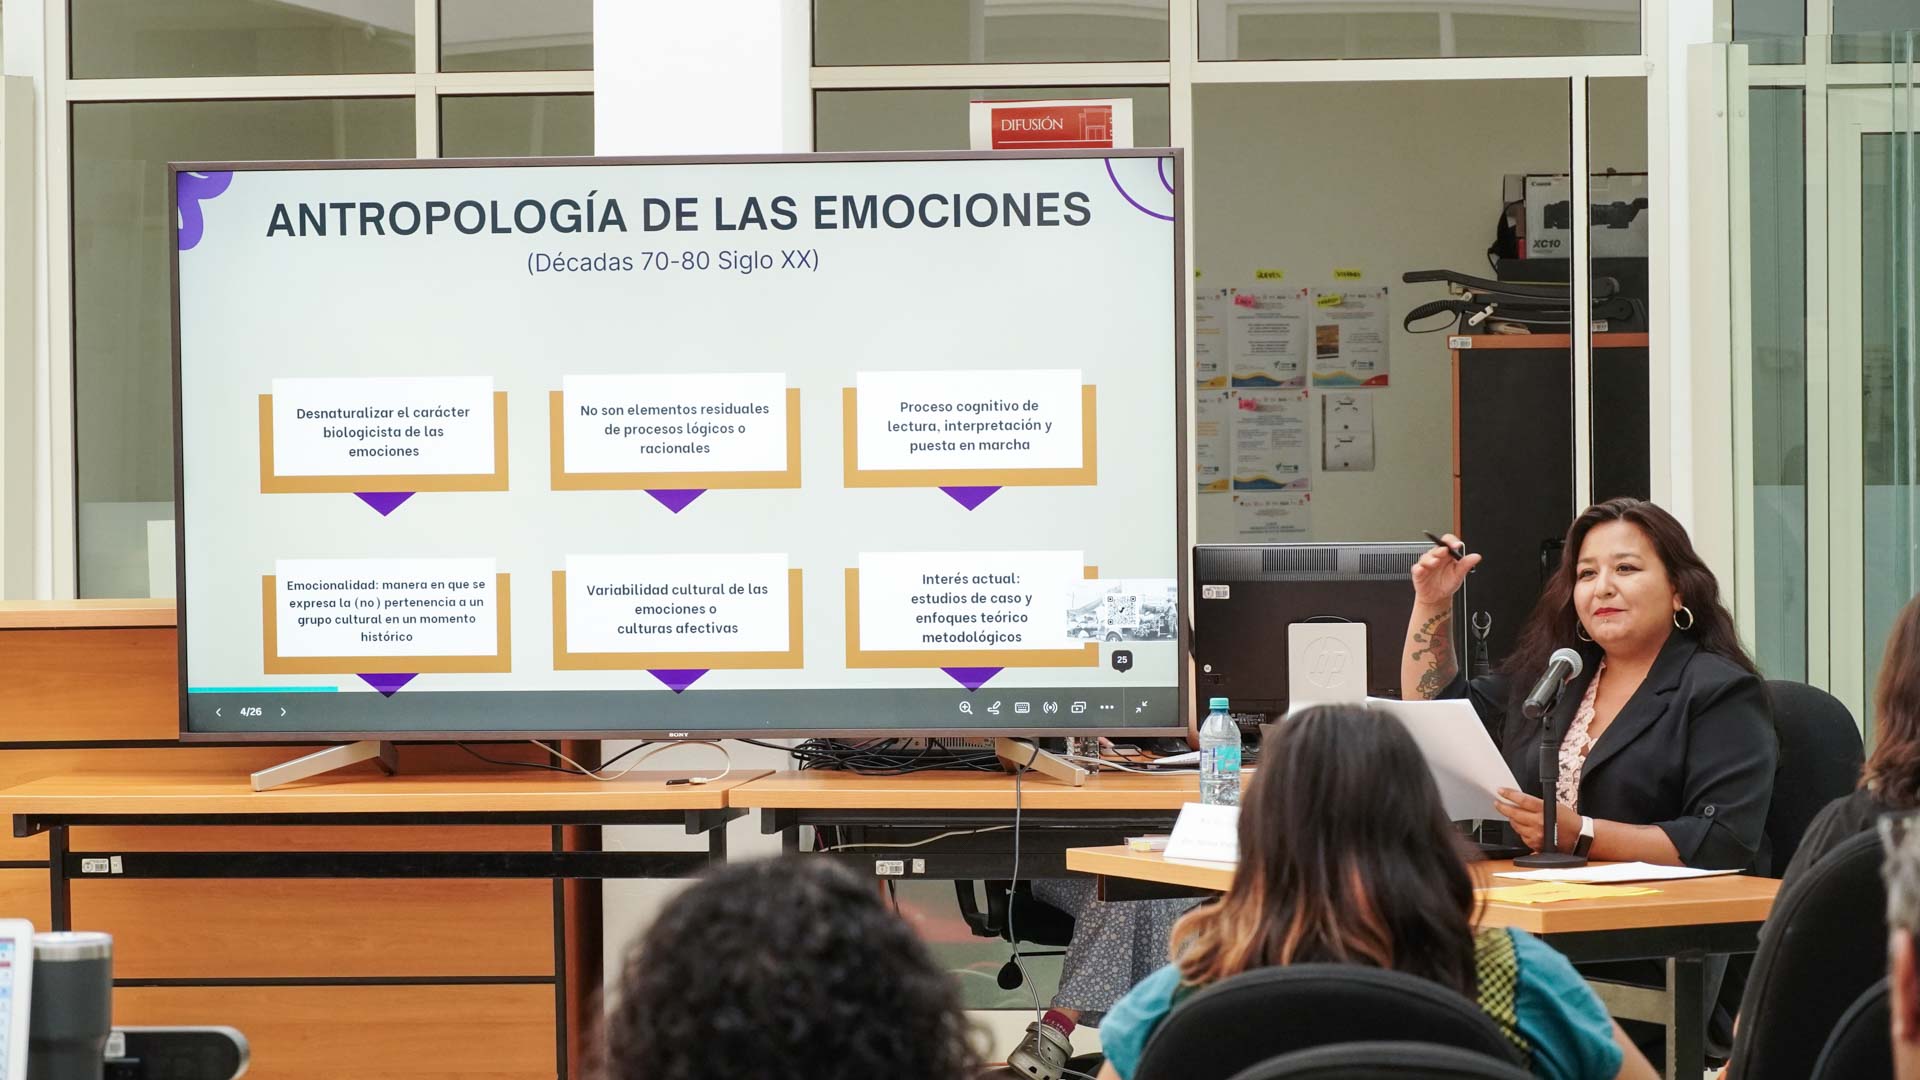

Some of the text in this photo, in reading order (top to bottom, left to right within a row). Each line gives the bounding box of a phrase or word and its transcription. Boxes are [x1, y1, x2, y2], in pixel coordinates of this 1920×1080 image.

[1001, 116, 1063, 131] DIFUSIÓN
[266, 190, 1091, 237] ANTROPOLOGÍA DE LAS EMOCIONES
[1533, 239, 1561, 249] XC10
[528, 249, 818, 276] (Décadas 70-80 Siglo XX)
[297, 405, 470, 419] Desnaturalizar el carácter
[581, 402, 769, 416] No son elementos residuales
[900, 399, 1039, 415] Proceso cognitivo de
[323, 425, 444, 439] biologicista de las
[604, 421, 746, 438] de procesos lógicos o
[888, 418, 1052, 434] lectura, interpretación y
[349, 445, 419, 457] emociones
[640, 442, 710, 454] racionales
[910, 438, 1030, 454] puesta en marcha
[287, 579, 378, 591] Emocionalidad:
[382, 582, 427, 590] manera
[448, 581, 469, 592] que
[473, 581, 485, 589] se
[923, 572, 1020, 585] Interés actual:
[586, 583, 768, 596] Variabilidad cultural de las
[289, 600, 336, 611] expresa
[339, 598, 351, 608] la
[384, 596, 456, 610] pertenencia
[459, 599, 466, 607] a
[469, 599, 484, 607] un
[911, 592, 1032, 607] estudios de caso y
[635, 602, 717, 615] emociones o
[298, 614, 476, 627] grupo cultural en un momento
[916, 610, 1028, 626] enfoques teórico
[617, 621, 738, 634] culturas afectivas
[361, 631, 413, 642] histórico
[922, 630, 1022, 646] metodológicos
[1117, 655, 1128, 664] 25
[240, 706, 262, 717] 4/26
